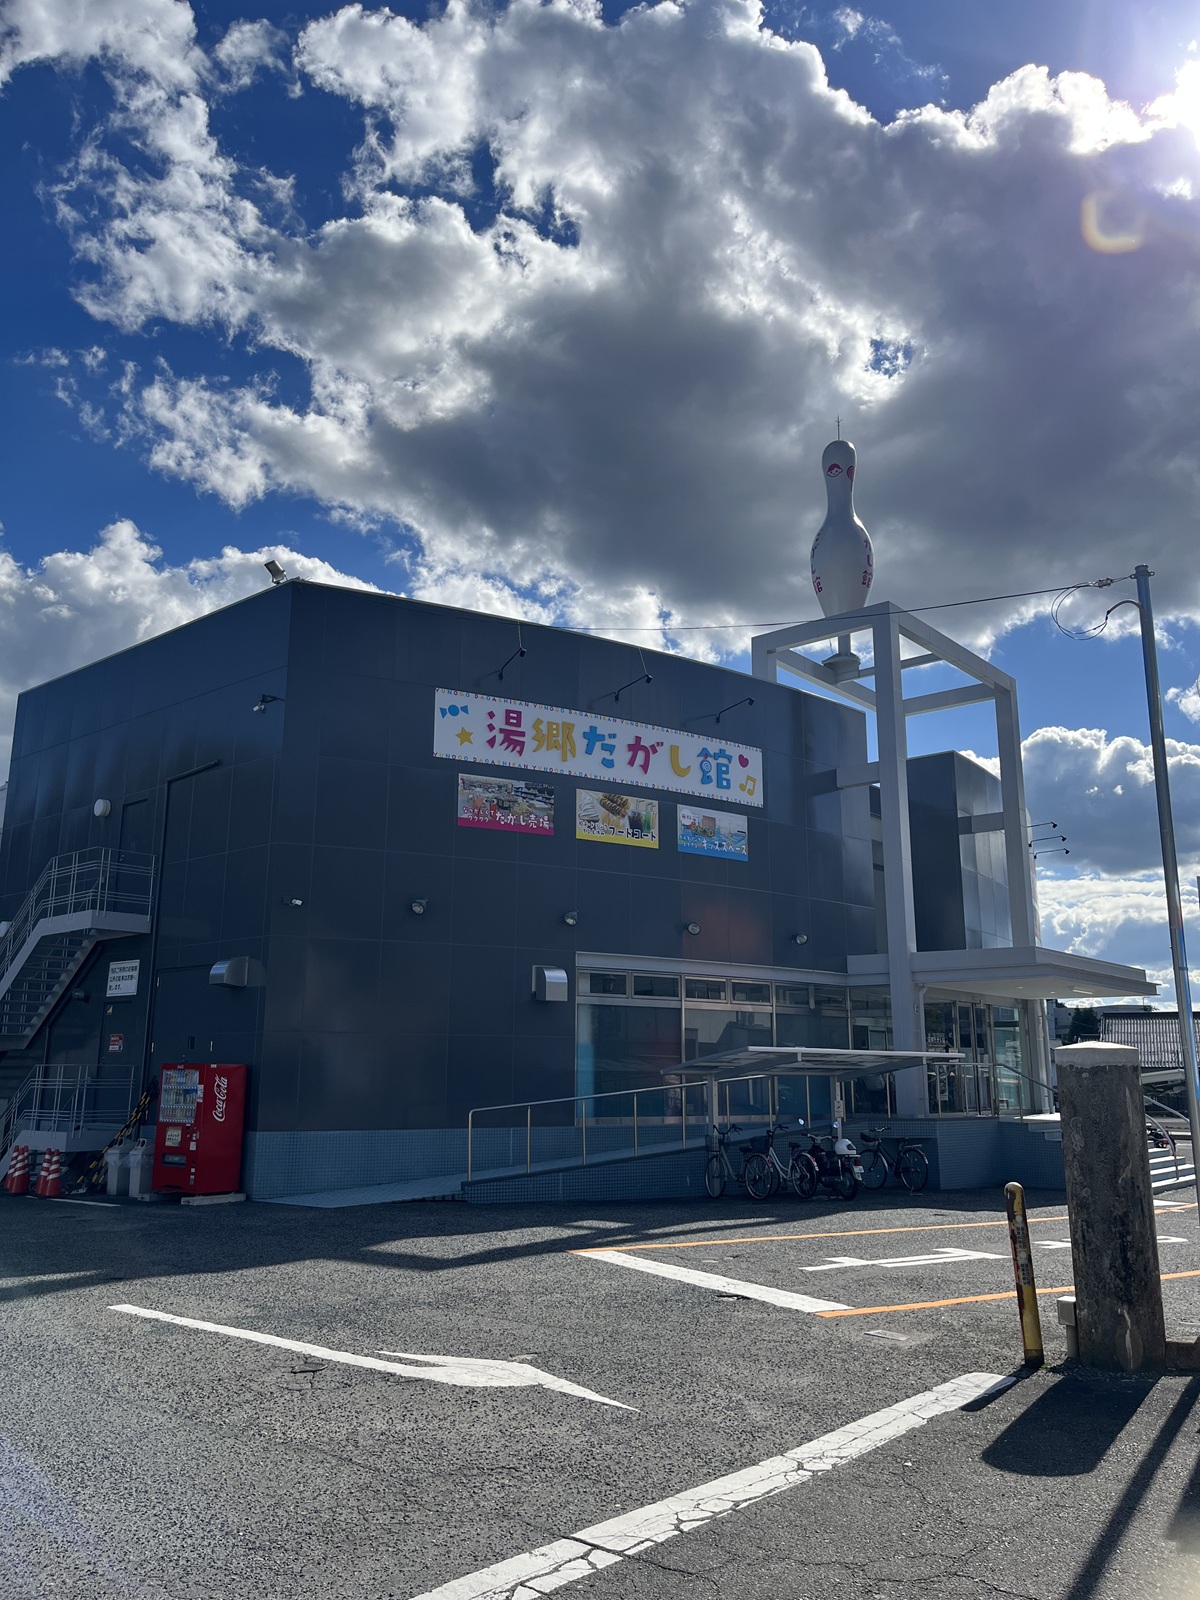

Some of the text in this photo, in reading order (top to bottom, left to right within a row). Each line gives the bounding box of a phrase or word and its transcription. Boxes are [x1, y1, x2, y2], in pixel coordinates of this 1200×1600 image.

[435, 688, 470, 698] YUNOGO
[474, 693, 529, 707] DAGASHIKAN
[533, 703, 565, 714] YUNOGO
[568, 708, 617, 723] DAGASHIKAN
[486, 708, 733, 789] 湯郷だがし館
[433, 752, 469, 761] YUNOGO
[473, 757, 528, 769] DAGASHIKAN
[532, 765, 564, 774] YUNOGO
[568, 770, 617, 783] DAGASHIKAN
[495, 811, 550, 830] だがし売場
[608, 826, 657, 843] フードコート
